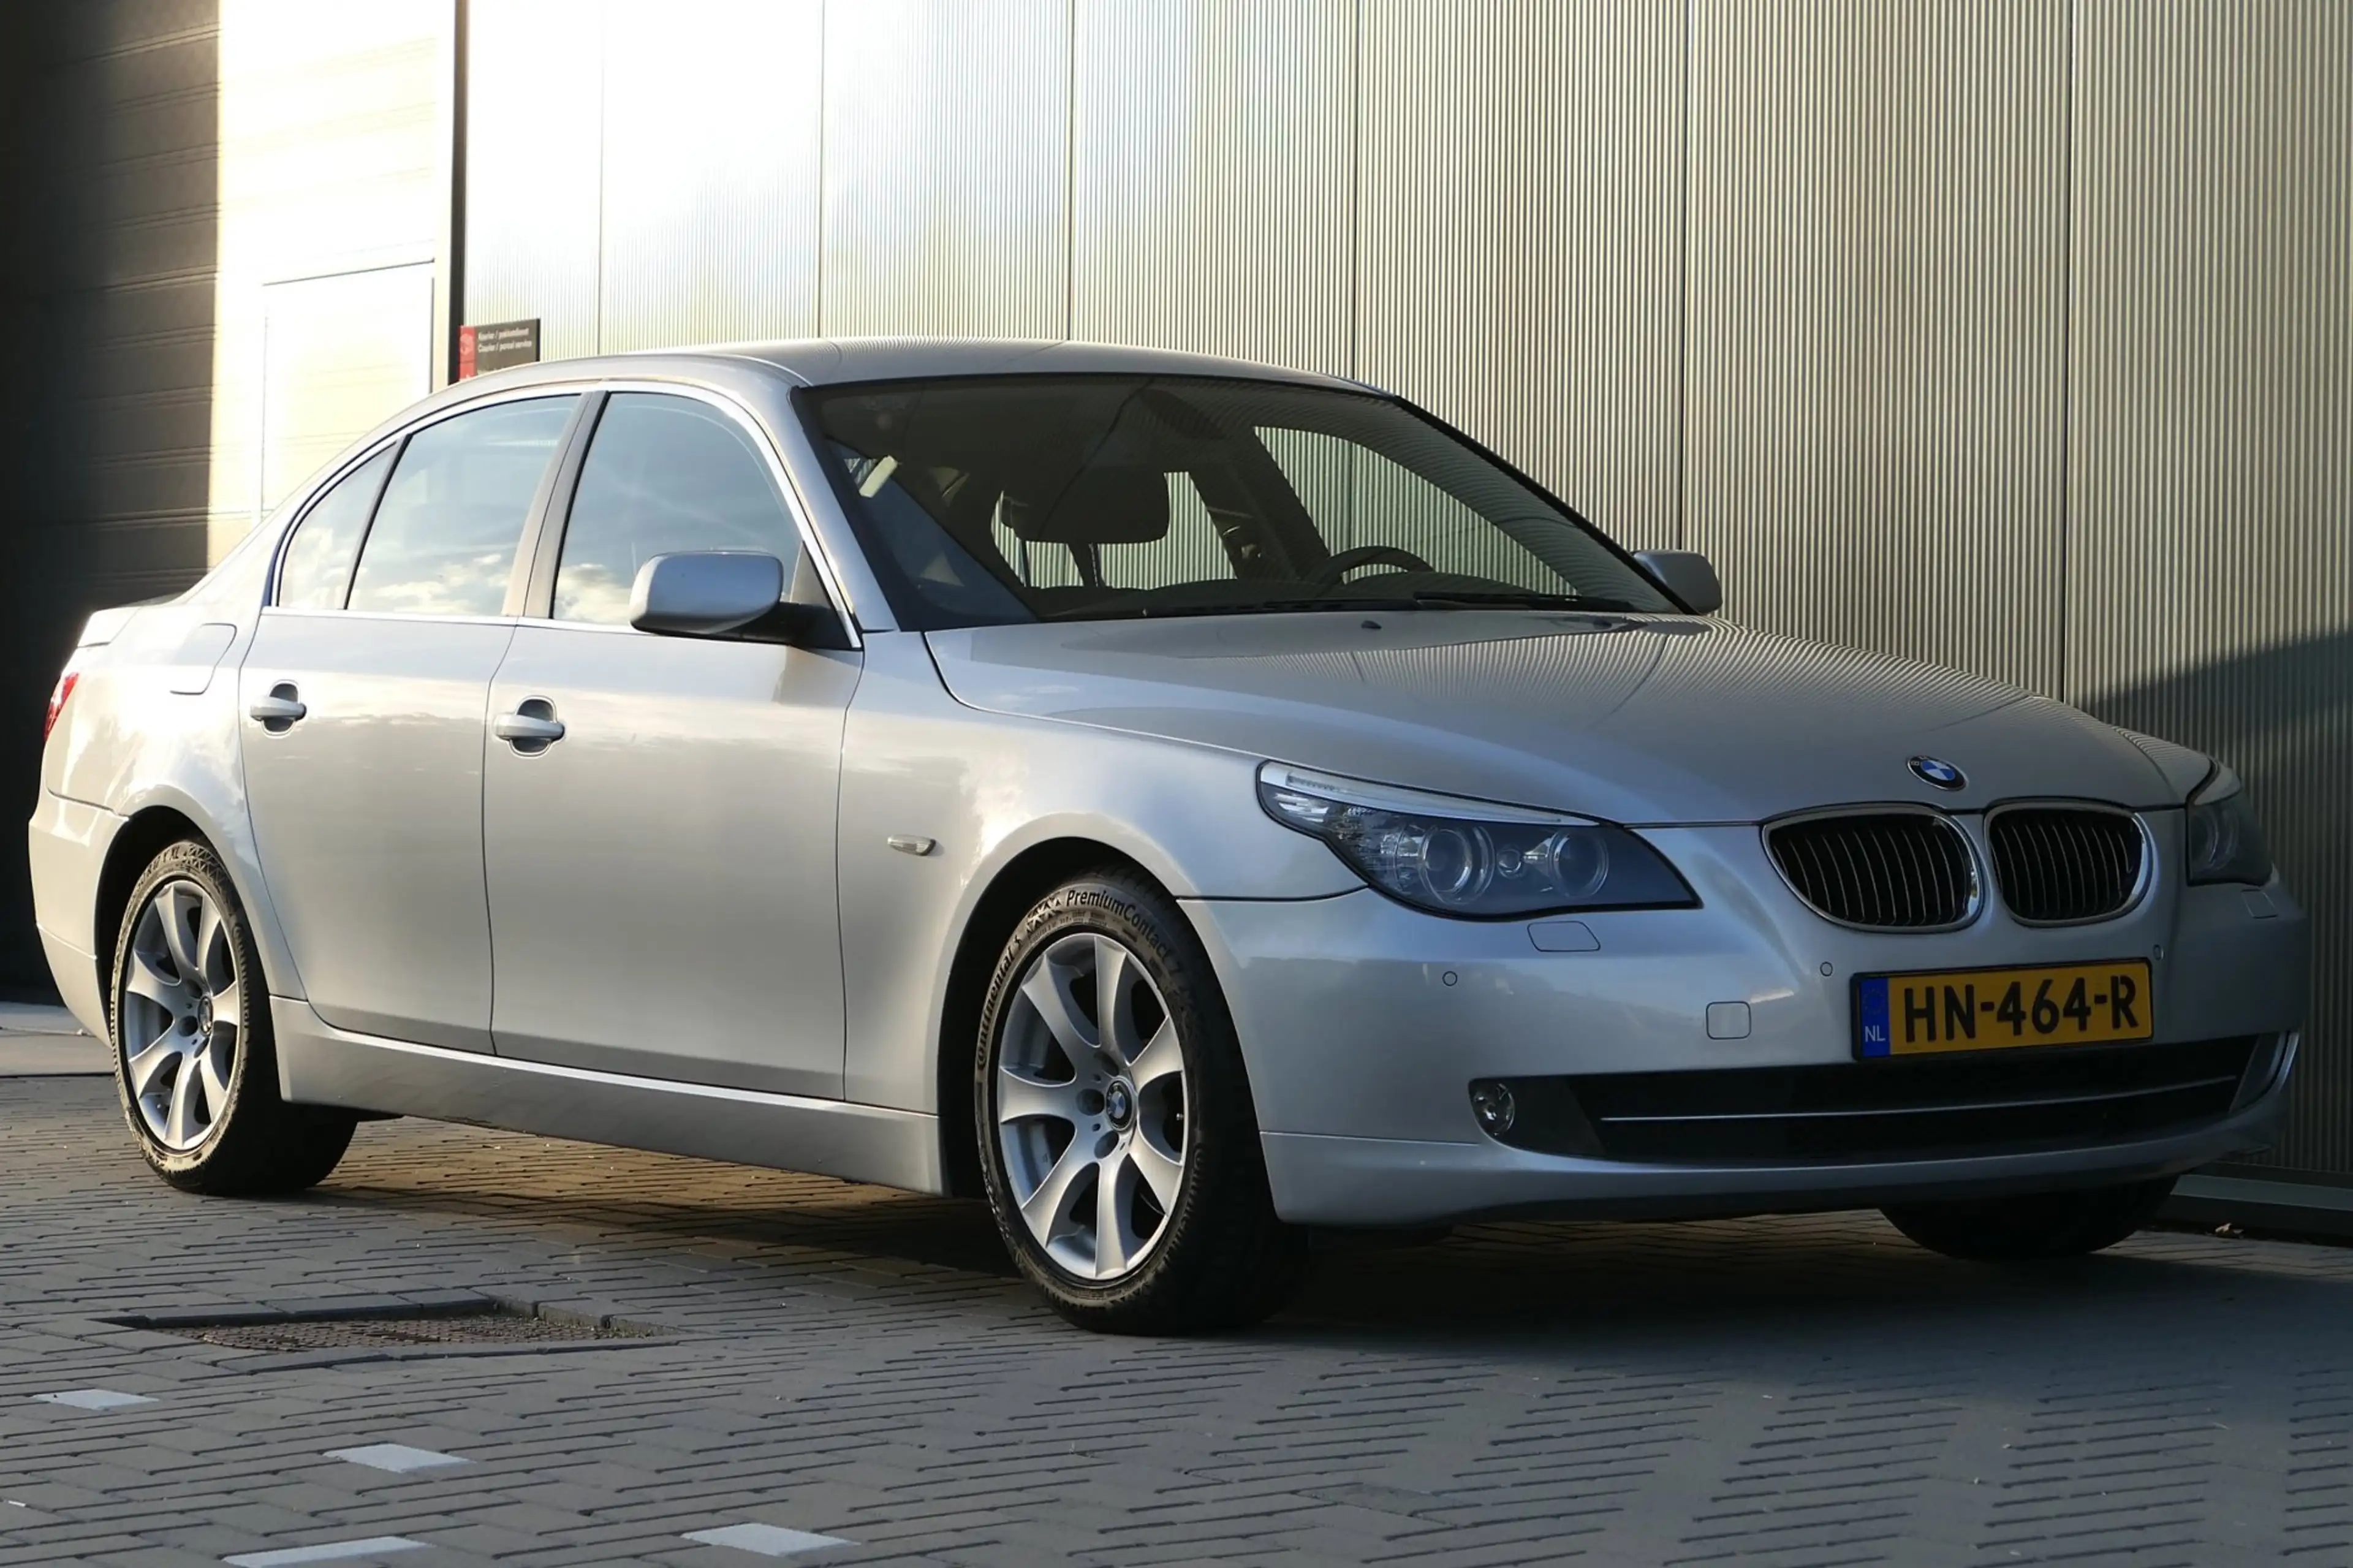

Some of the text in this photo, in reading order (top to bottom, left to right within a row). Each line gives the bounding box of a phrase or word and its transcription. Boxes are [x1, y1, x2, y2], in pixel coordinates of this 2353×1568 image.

[1066, 889, 1173, 963] PremiumContact
[1865, 1025, 1886, 1043] NL
[1904, 975, 2139, 1043] HN-464-R
